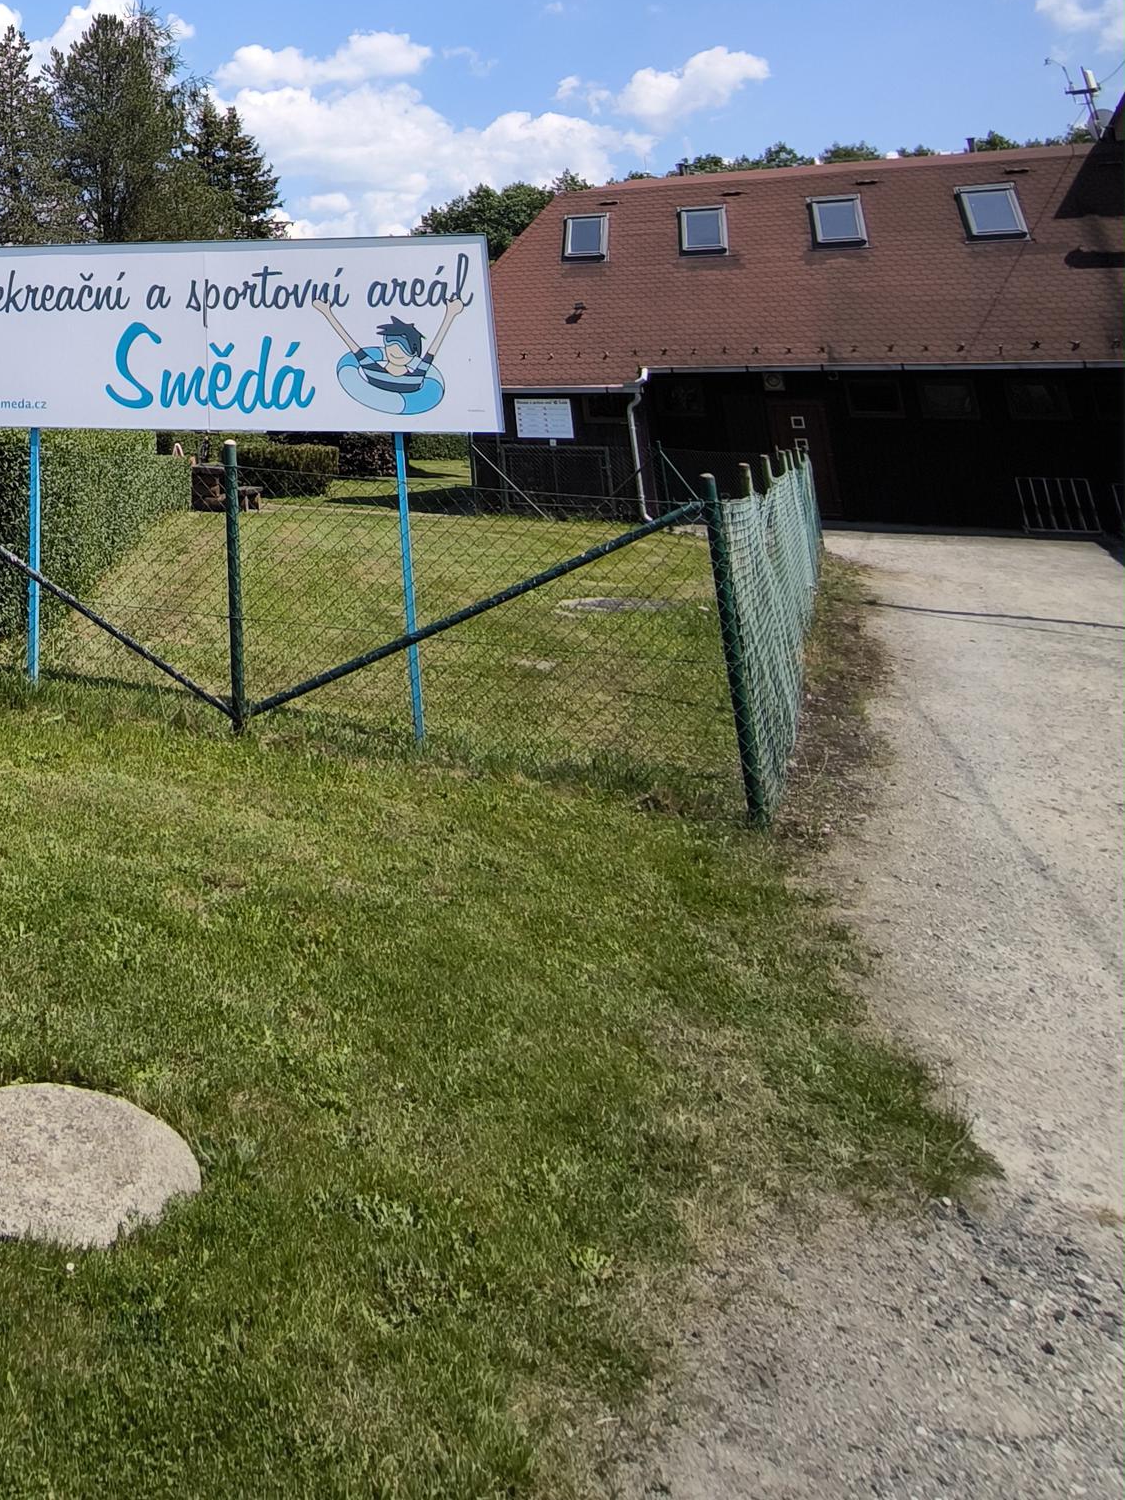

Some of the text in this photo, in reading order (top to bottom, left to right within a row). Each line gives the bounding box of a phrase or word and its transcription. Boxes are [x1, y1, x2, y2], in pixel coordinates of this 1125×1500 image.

[146, 284, 171, 310] a
[186, 265, 350, 328] sportovní
[367, 253, 474, 308] areál
[105, 321, 316, 414] Smědá
